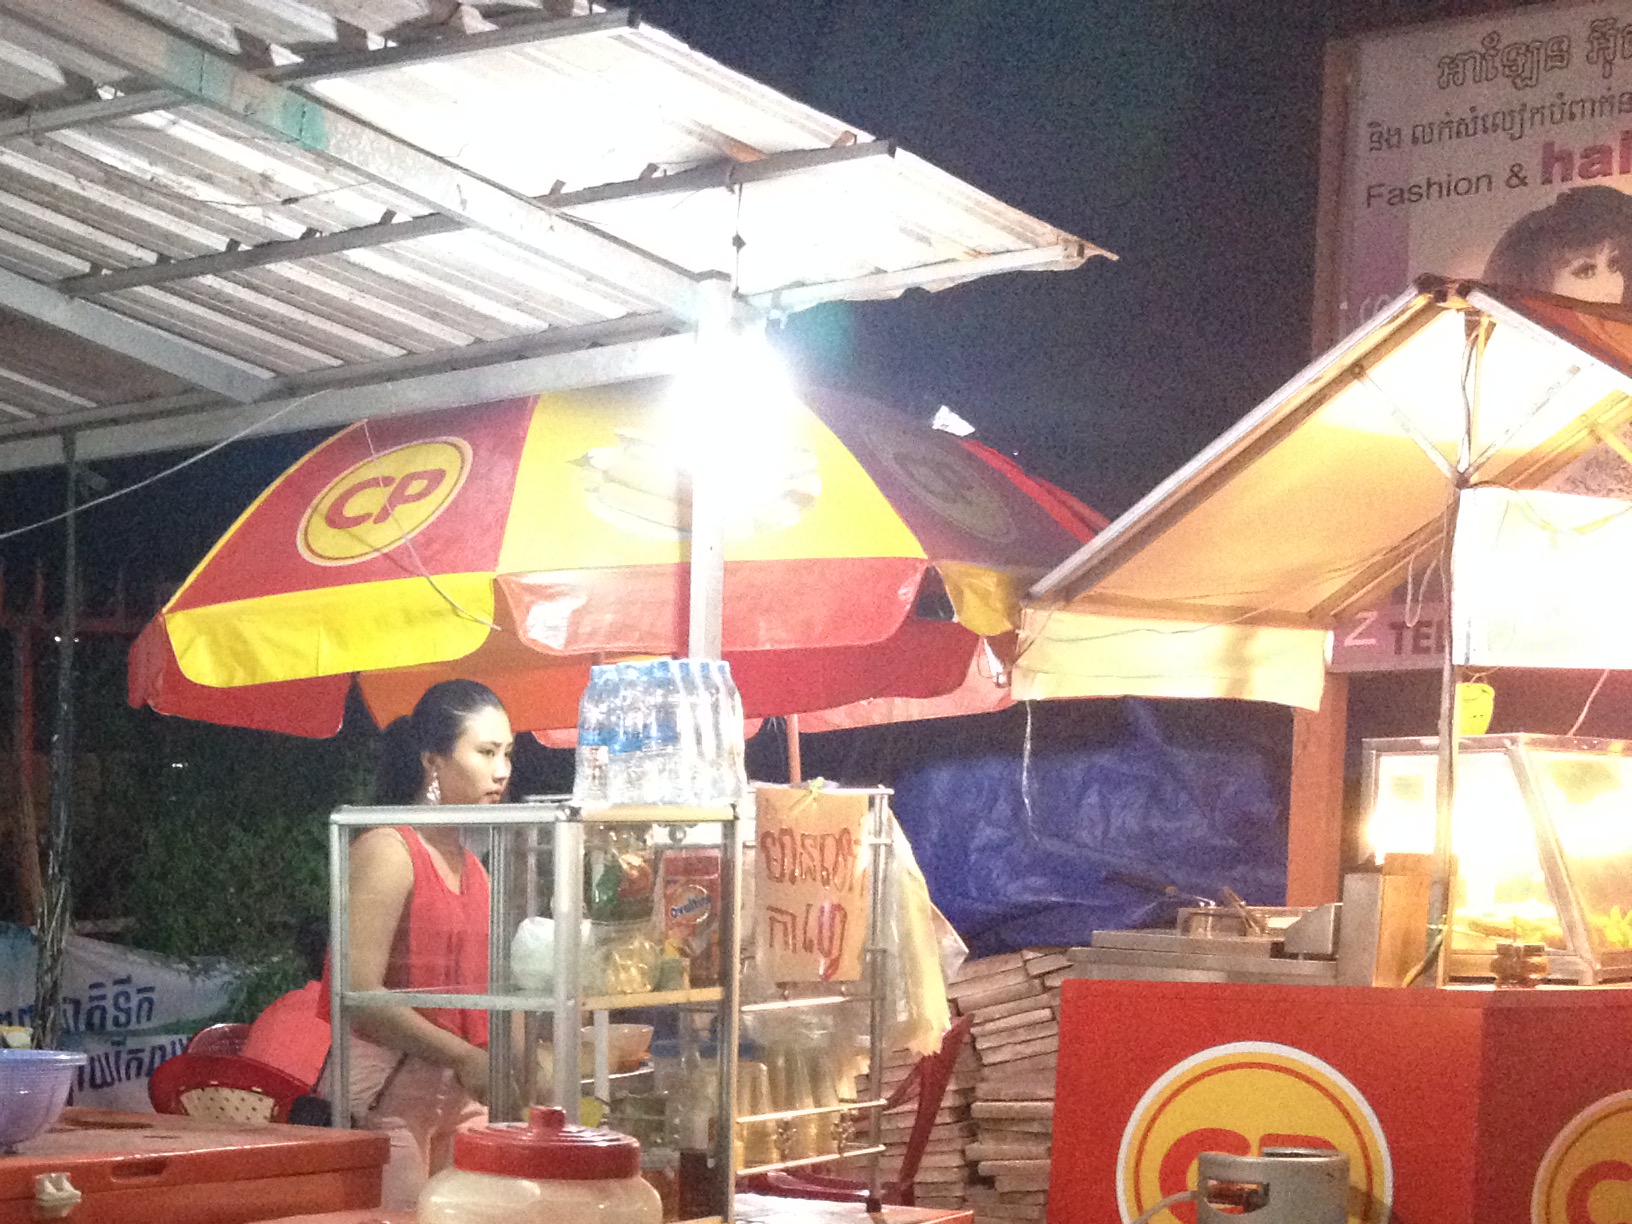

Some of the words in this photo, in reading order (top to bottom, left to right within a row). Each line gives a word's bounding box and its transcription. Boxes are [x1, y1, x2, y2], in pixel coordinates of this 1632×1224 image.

[1366, 172, 1494, 209] Fashion
[1505, 162, 1529, 190] &
[324, 468, 447, 530] CP
